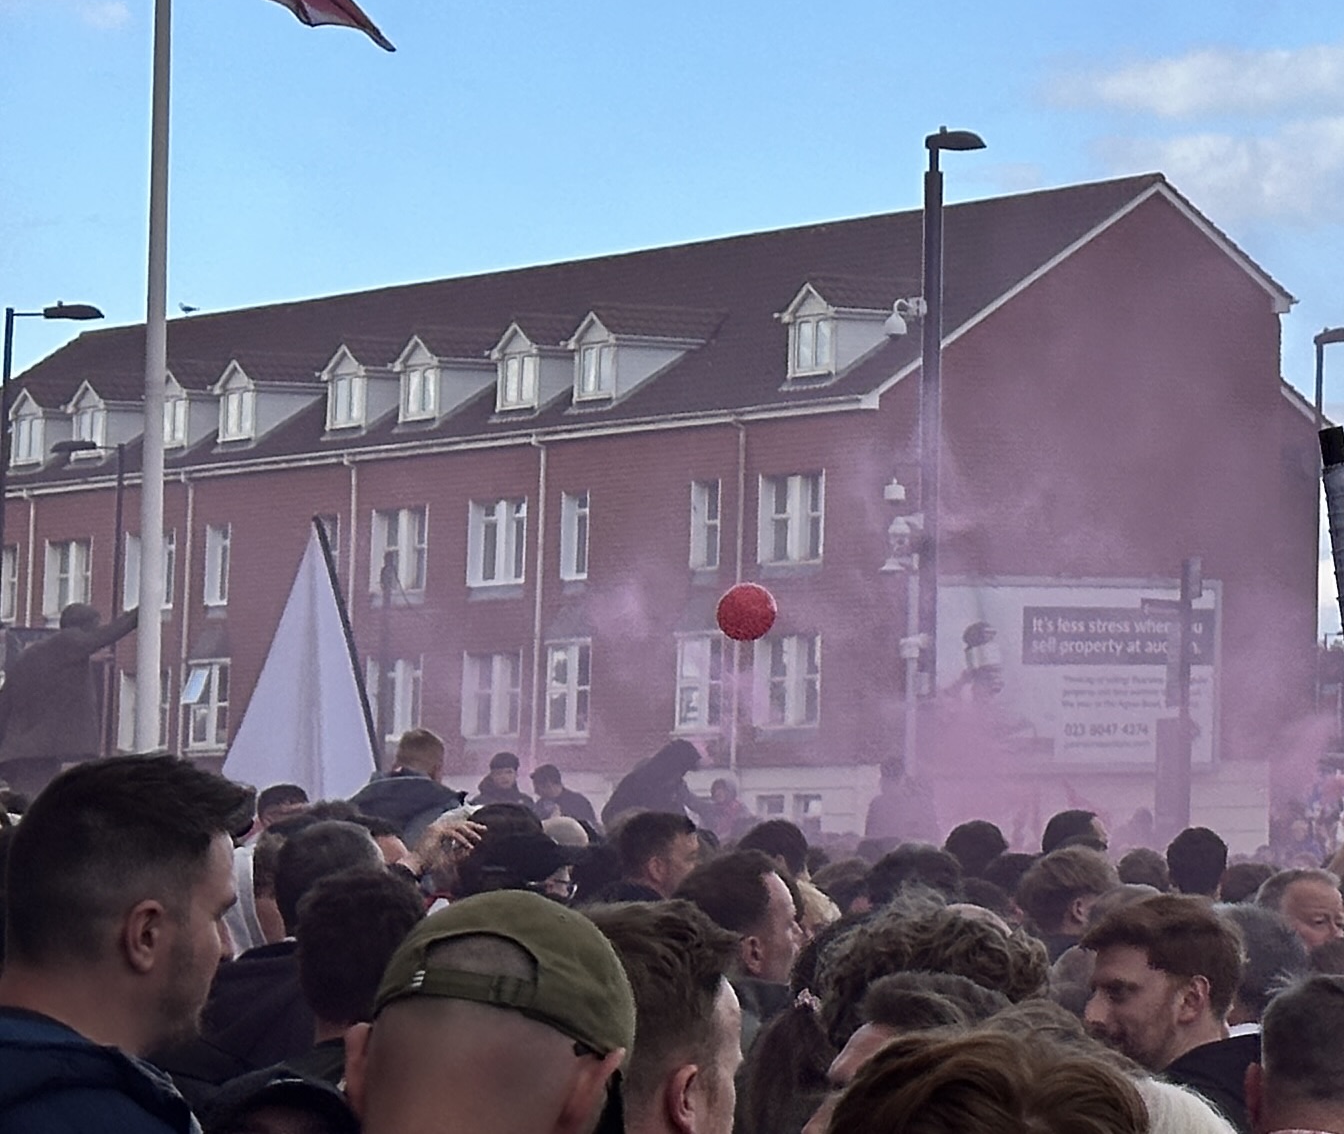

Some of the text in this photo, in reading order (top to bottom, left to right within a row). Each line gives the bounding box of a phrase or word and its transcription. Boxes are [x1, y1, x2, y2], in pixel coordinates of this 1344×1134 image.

[1032, 617, 1054, 633] It's
[1089, 617, 1130, 634] stress
[1032, 636, 1056, 653] sell
[1059, 638, 1123, 656] property
[1126, 639, 1142, 653] at
[1063, 723, 1086, 737] 023
